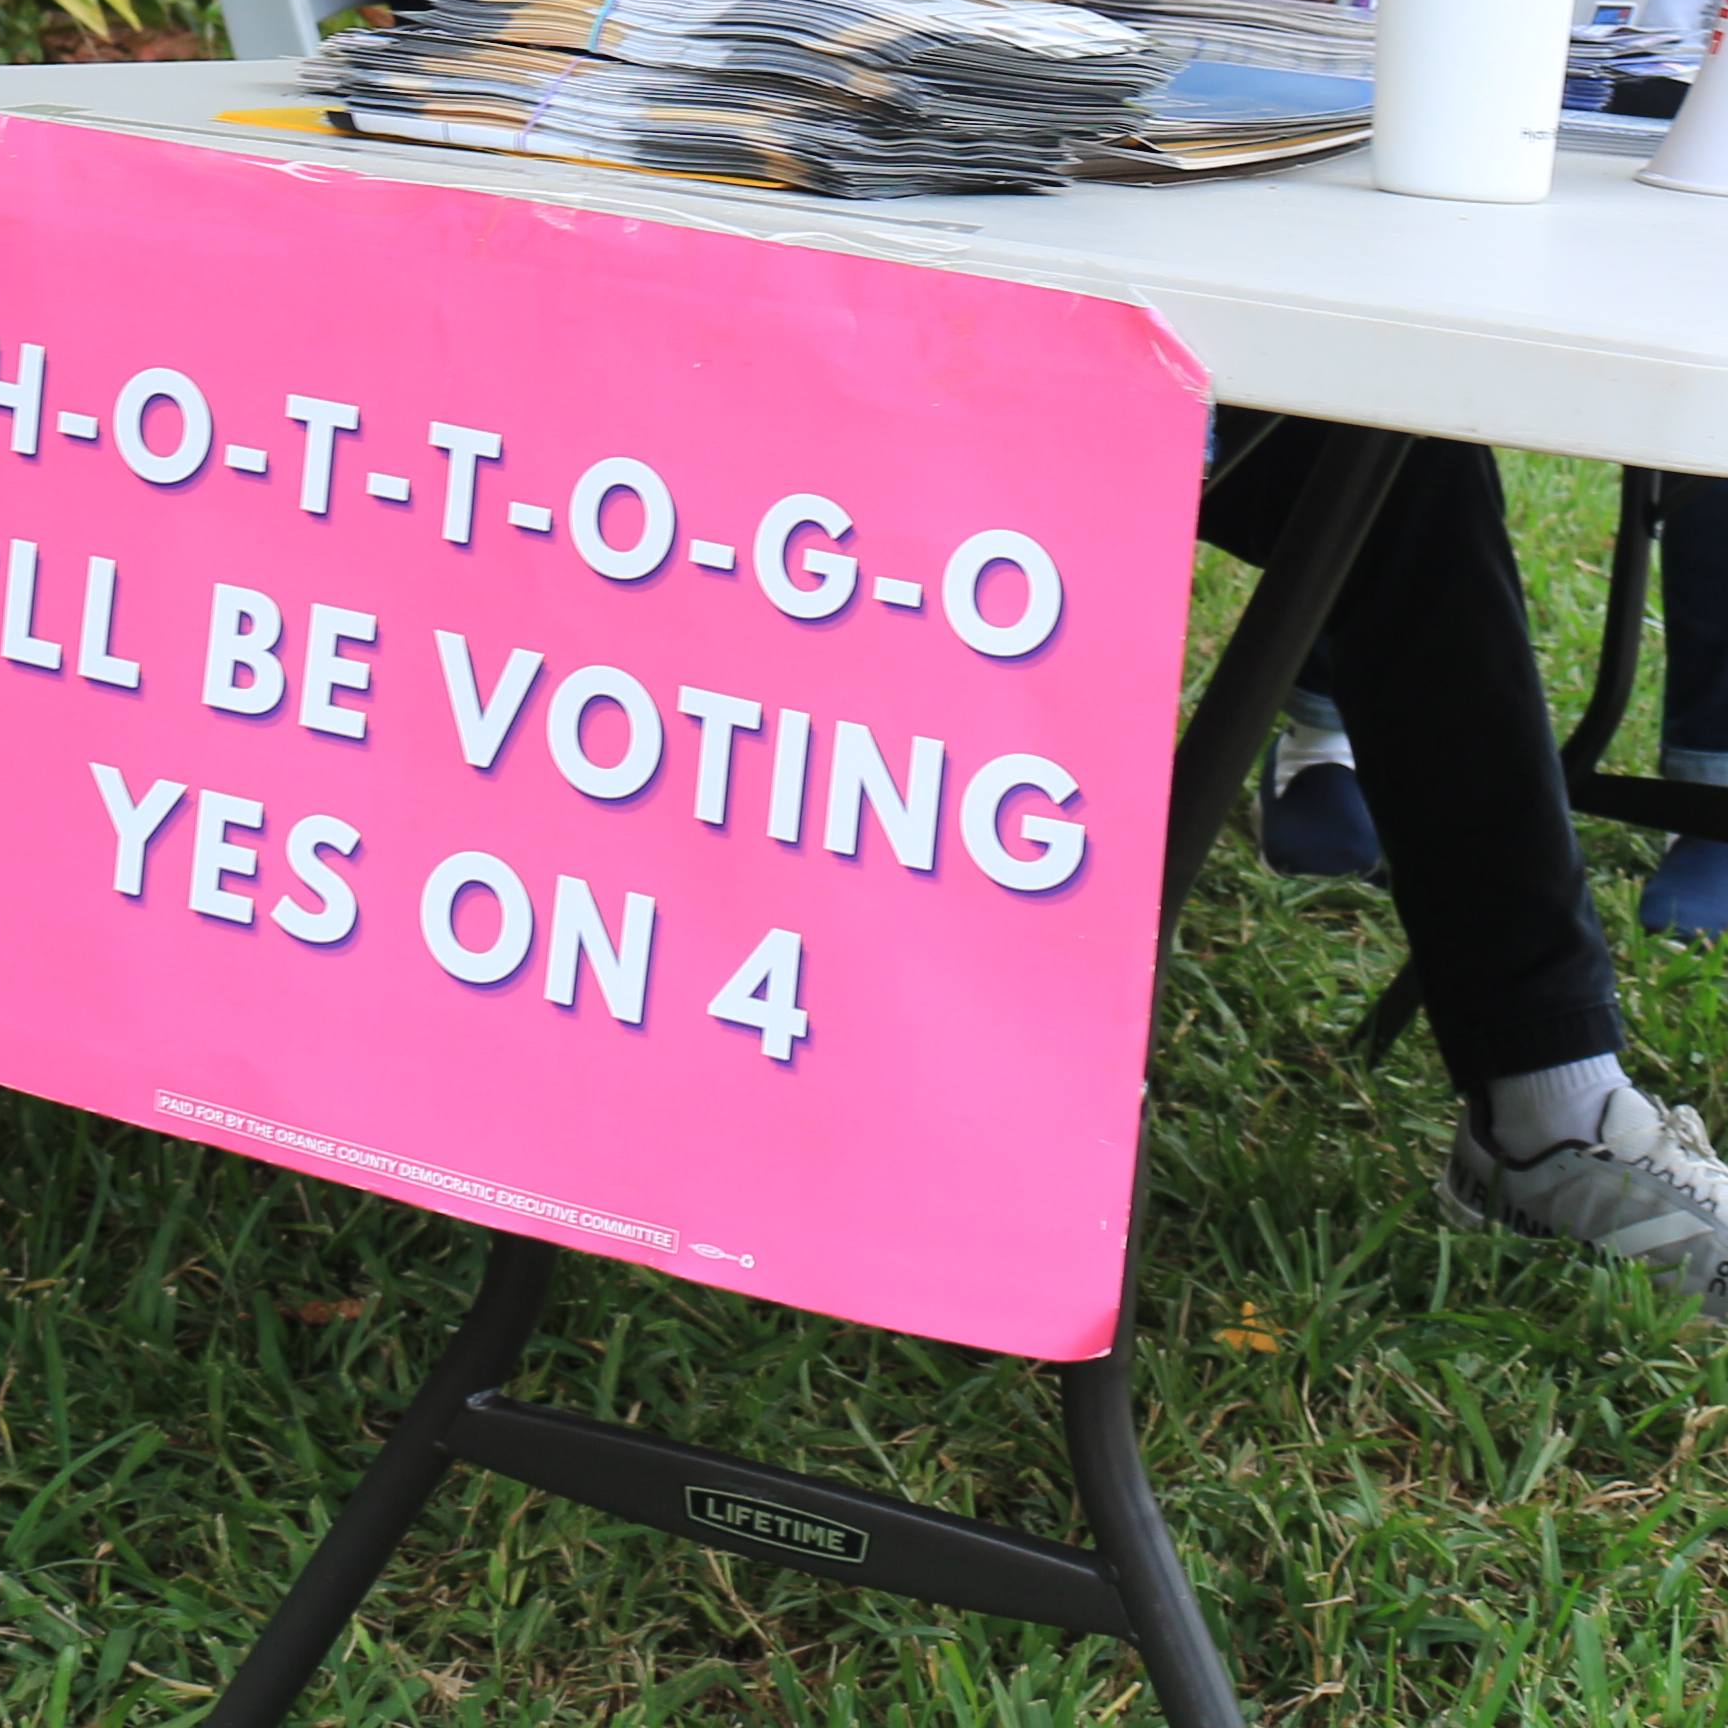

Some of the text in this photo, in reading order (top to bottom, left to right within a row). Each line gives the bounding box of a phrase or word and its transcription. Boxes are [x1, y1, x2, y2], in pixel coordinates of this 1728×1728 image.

[202, 582, 378, 741] BE
[433, 627, 1088, 895] VOTING
[89, 762, 810, 1062] YES ON 4
[160, 1095, 673, 1248] PAID FOR BY THE ORANGE COUNTY DEMOCRATIC EXECUTIVE COMMITTEE
[704, 1495, 847, 1553] LIFETIME
